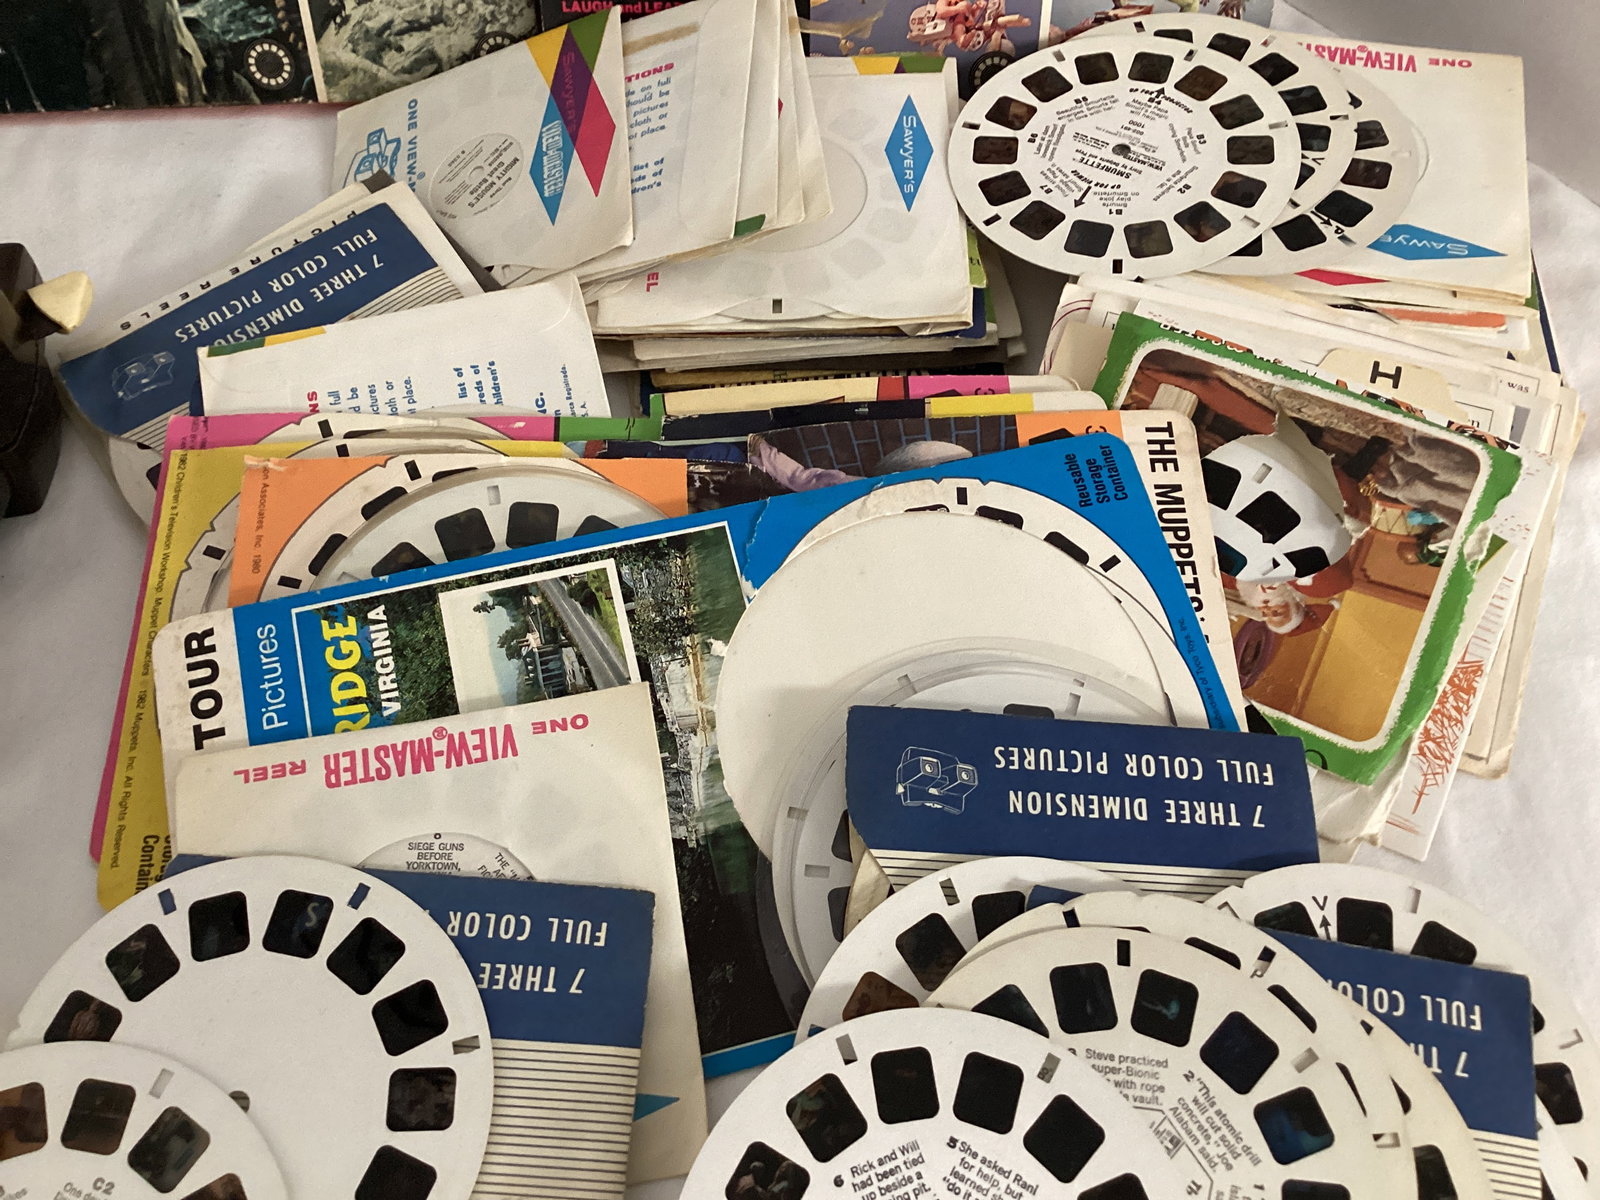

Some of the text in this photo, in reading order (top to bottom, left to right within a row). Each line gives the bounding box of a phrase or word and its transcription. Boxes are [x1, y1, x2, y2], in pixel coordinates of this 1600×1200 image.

[1428, 57, 1473, 69] ONE
[658, 89, 670, 98] be
[407, 99, 418, 131] ONE
[632, 101, 669, 118] pictures
[658, 112, 668, 121] or
[496, 157, 520, 181] MIGHTY
[652, 169, 663, 177] of
[653, 157, 665, 165] of
[1079, 156, 1133, 179] SMURFETTE
[372, 253, 385, 270] 7
[174, 228, 379, 344] FULL COLOR PICTURES
[311, 263, 368, 303] THREE
[453, 367, 468, 399] list of
[470, 364, 480, 375] of
[1369, 360, 1403, 389] H
[327, 390, 341, 406] full
[347, 386, 359, 401] be
[385, 380, 395, 391] or
[402, 376, 417, 405] place.
[1507, 381, 1531, 394] was
[1144, 421, 1180, 473] THE
[1064, 452, 1094, 509] Reusable
[1085, 458, 1111, 505] Storage
[1099, 444, 1129, 502] Container
[163, 511, 179, 551] Television
[149, 597, 163, 628] Muppet
[367, 604, 402, 717] VIRGINIA
[184, 627, 226, 751] TOUR
[256, 623, 289, 731] Pictures
[135, 689, 148, 710] 1982
[531, 713, 590, 735] ONE
[233, 759, 307, 784] REEL
[993, 746, 1275, 787] FULL COLOR PICTURES
[123, 775, 134, 789] All
[117, 791, 132, 822] Rights
[1008, 789, 1266, 828] 7 THREE DIMENSION
[407, 842, 465, 852] SIEGE GUNS
[416, 851, 454, 861] BEFORE
[405, 861, 462, 872] YORKTOWN,
[494, 852, 510, 870] THE
[446, 910, 609, 947] FULL COLOR
[477, 962, 586, 994] 7 THREE
[1420, 994, 1483, 1032] FULL
[1084, 1048, 1116, 1062] Steve
[1118, 1052, 1169, 1069] practiced
[1454, 1051, 1470, 1078] 7
[1113, 1078, 1166, 1094] with rope
[1132, 1094, 1164, 1106] vault.
[1183, 1069, 1196, 1083] 2
[1214, 1108, 1244, 1144] atomic
[1241, 1141, 1263, 1167] drill
[1191, 1095, 1243, 1161] will cut solid
[1169, 1105, 1219, 1173] Alabam said.
[833, 1139, 921, 1188] 6 Rick and Will
[946, 1135, 959, 1150] 5
[958, 1140, 980, 1160] She
[979, 1154, 1012, 1180] asked
[1216, 1149, 1235, 1173] Joe
[92, 1176, 116, 1196] C2
[851, 1154, 926, 1193] had been tied
[878, 1170, 924, 1197] beside a
[948, 1166, 990, 1197] learned
[958, 1156, 977, 1172] for
[1004, 1181, 1025, 1200] but
[913, 1181, 932, 1200] pit.
